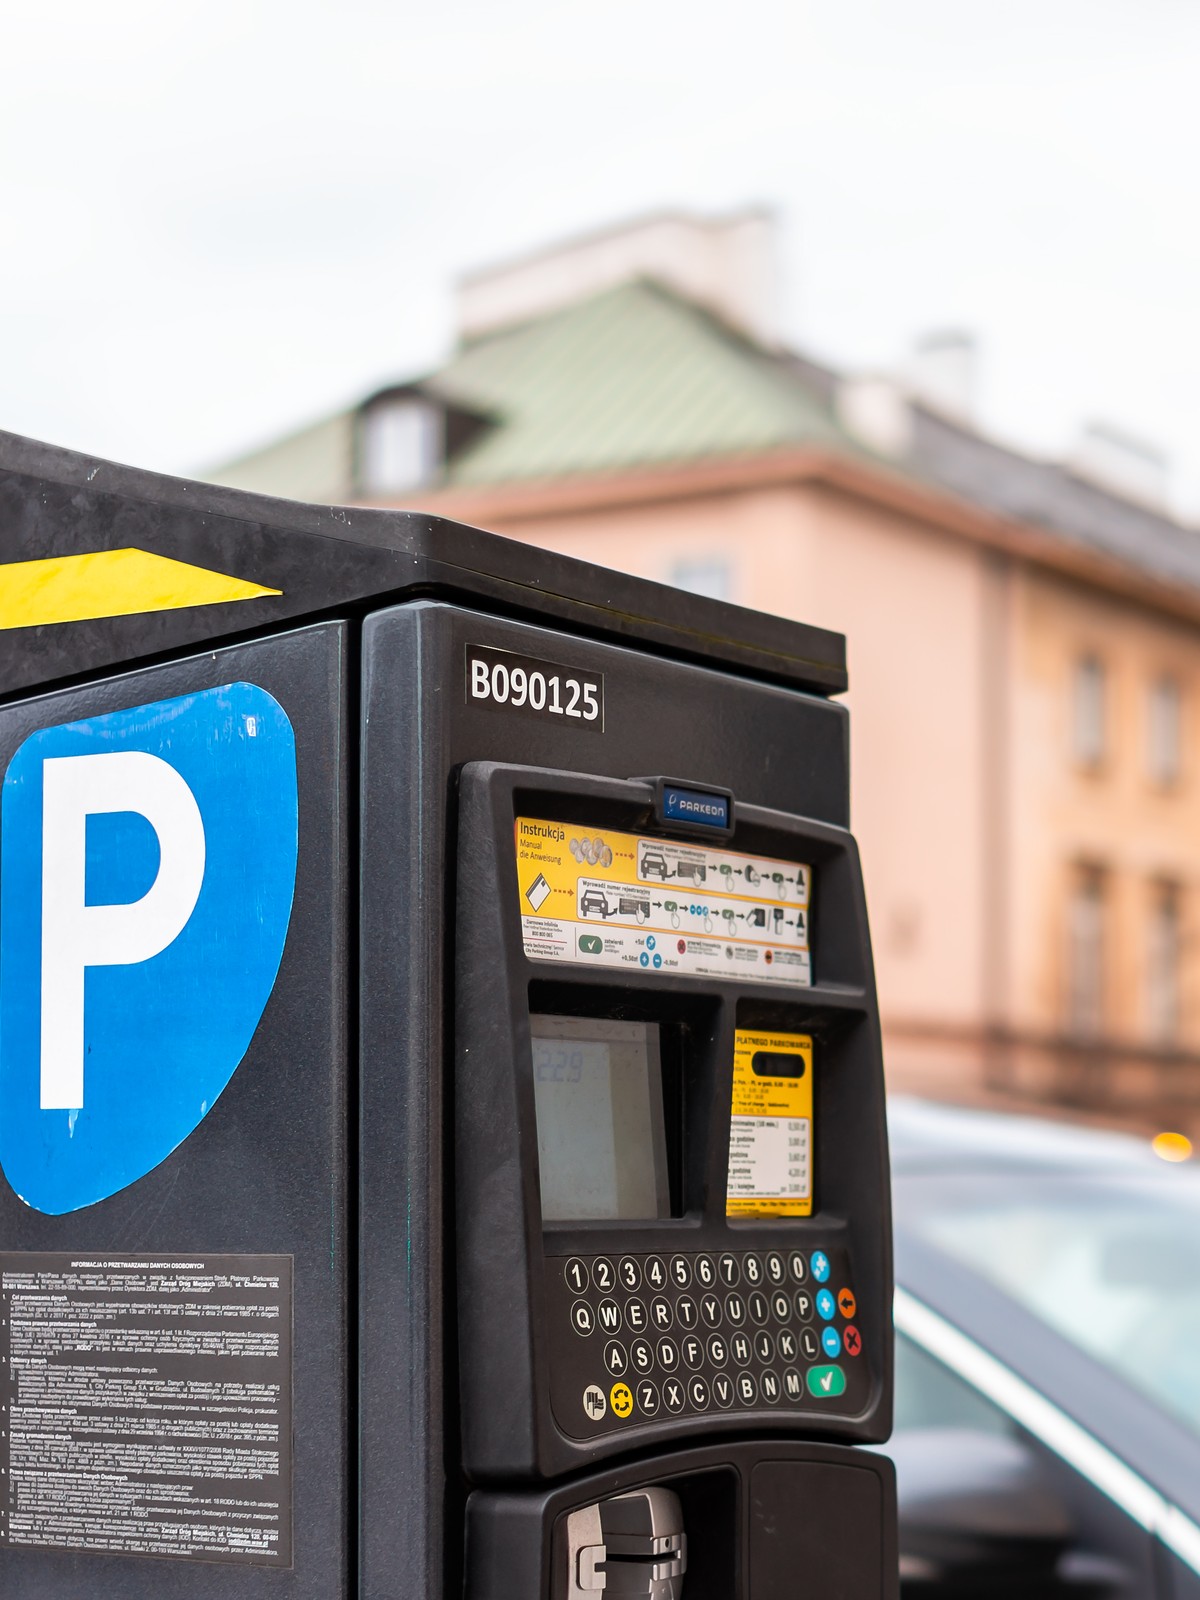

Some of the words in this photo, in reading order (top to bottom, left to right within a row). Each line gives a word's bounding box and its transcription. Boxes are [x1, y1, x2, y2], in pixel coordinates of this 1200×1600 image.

[472, 659, 599, 721] B090125
[680, 800, 724, 817] PARKEON
[520, 822, 565, 842] Instrukcja
[520, 839, 542, 850] Manual
[520, 850, 529, 859] die
[530, 852, 562, 865] Anweisung
[40, 750, 206, 1109] P
[572, 1264, 581, 1287] 1
[598, 1264, 610, 1287] 2
[624, 1263, 636, 1285] 3
[651, 1262, 662, 1284] 4
[677, 1261, 687, 1283] 5
[700, 1261, 711, 1282] 6
[724, 1260, 733, 1281] 7
[749, 1259, 758, 1280] 8
[772, 1259, 781, 1280] 9
[794, 1259, 804, 1278] 0
[577, 1309, 591, 1329] Q
[601, 1308, 617, 1327] W
[631, 1306, 642, 1325] E
[656, 1304, 668, 1323] R
[681, 1304, 691, 1322] T
[705, 1303, 715, 1320] Y
[730, 1301, 741, 1319] U
[756, 1300, 762, 1318] I
[776, 1299, 787, 1316] O
[799, 1298, 808, 1315] P
[611, 1349, 623, 1369] A
[637, 1348, 648, 1366] S
[663, 1345, 674, 1364] D
[689, 1344, 697, 1362] F
[712, 1342, 723, 1360] G
[737, 1340, 747, 1358] H
[761, 1339, 768, 1356] J
[782, 1337, 794, 1355] K
[805, 1335, 815, 1353] L
[643, 1389, 654, 1408] Z
[669, 1386, 680, 1405] X
[694, 1385, 705, 1403] C
[718, 1383, 728, 1401] V
[743, 1381, 753, 1398] B
[766, 1378, 776, 1396] N
[788, 1375, 800, 1393] M
